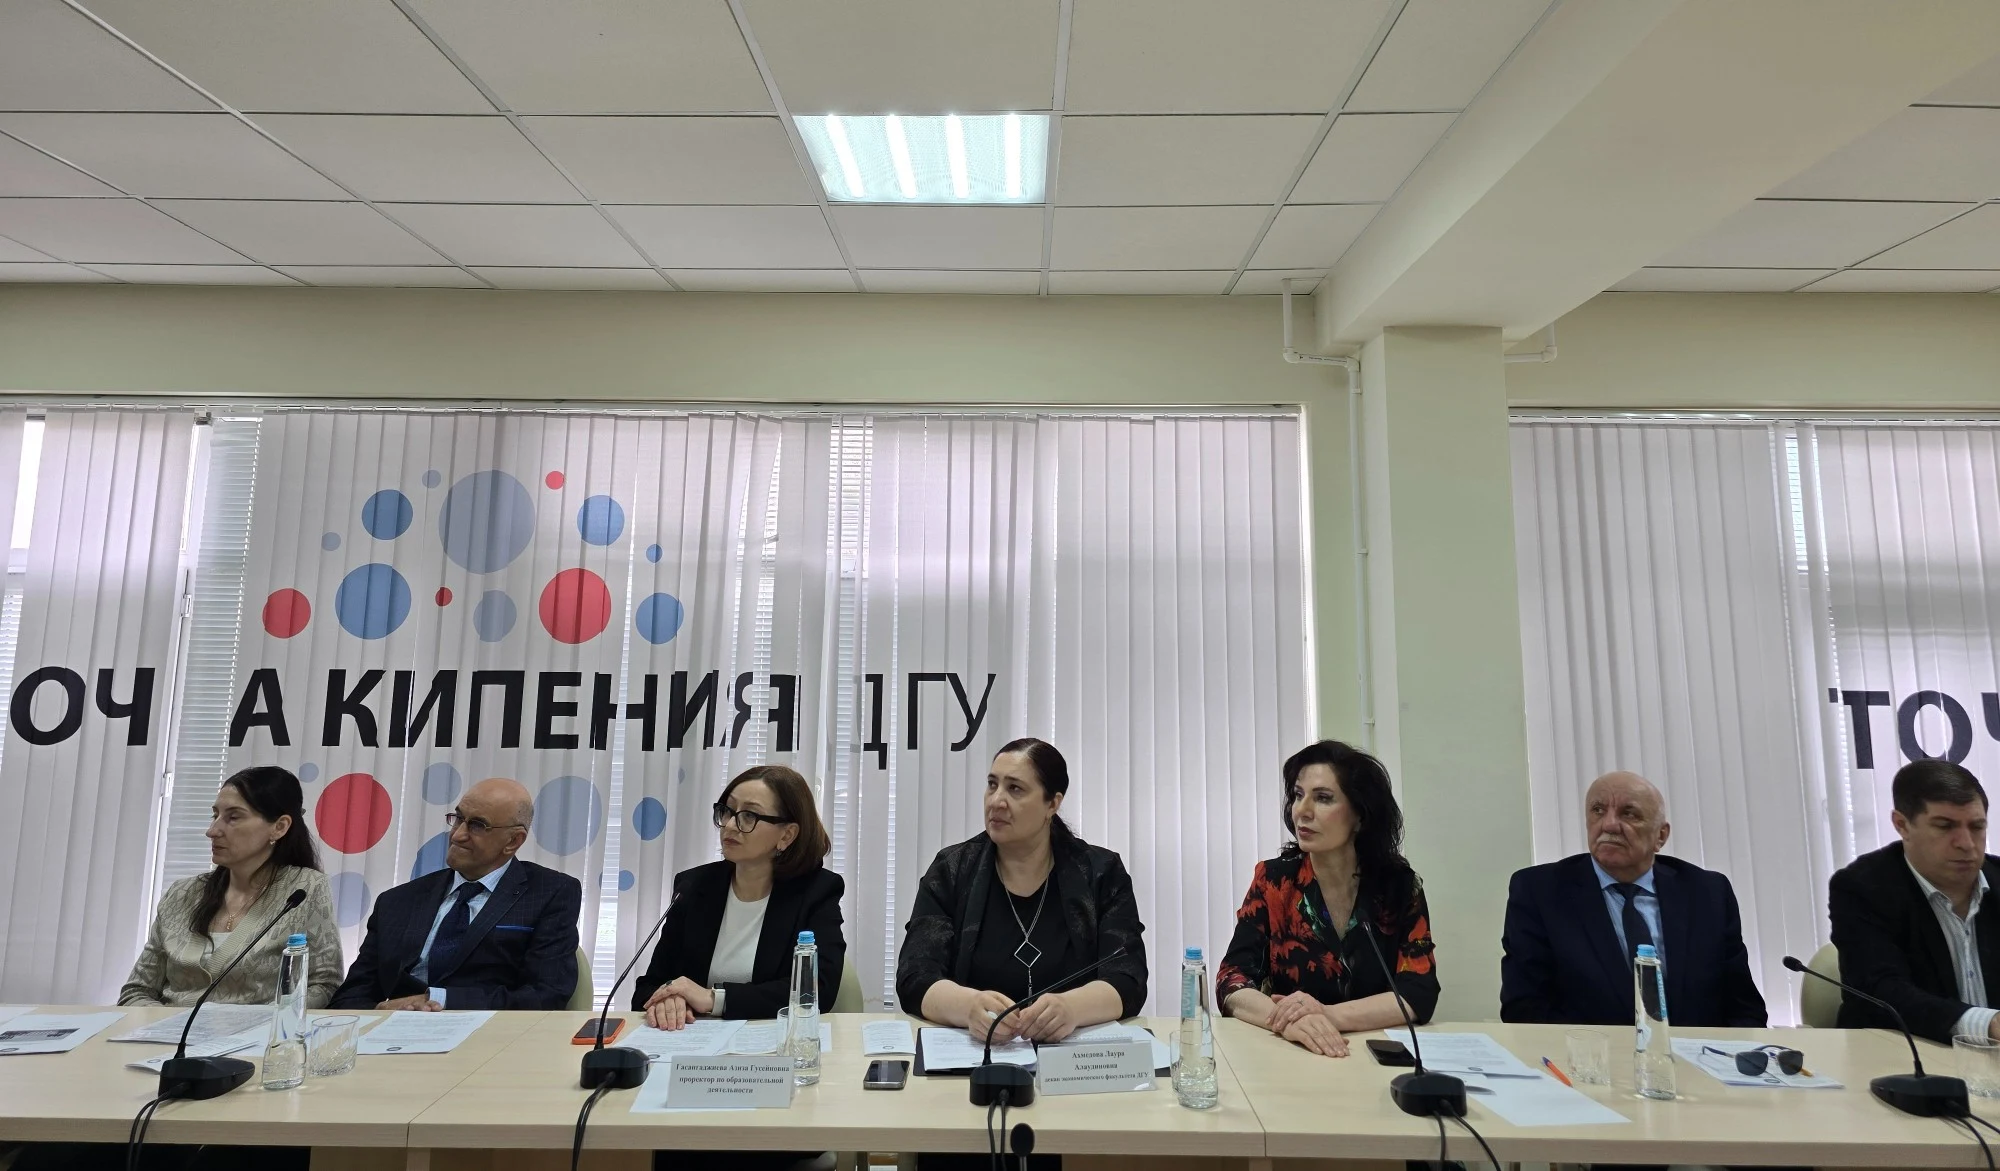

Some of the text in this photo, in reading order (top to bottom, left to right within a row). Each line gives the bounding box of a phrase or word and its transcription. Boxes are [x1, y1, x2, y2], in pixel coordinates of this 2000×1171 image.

[321, 668, 801, 752] КИПЕНИЯ
[1072, 1050, 1125, 1059] Ахмедова Лаура
[676, 1063, 790, 1074] Гасангаджиева Азиза Гусейновна
[1074, 1063, 1118, 1072] Алаудиновна
[1136, 1071, 1150, 1079] ДГУ
[679, 1076, 715, 1084] проректор
[726, 1076, 784, 1085] образовательной
[707, 1086, 754, 1094] деятельности
